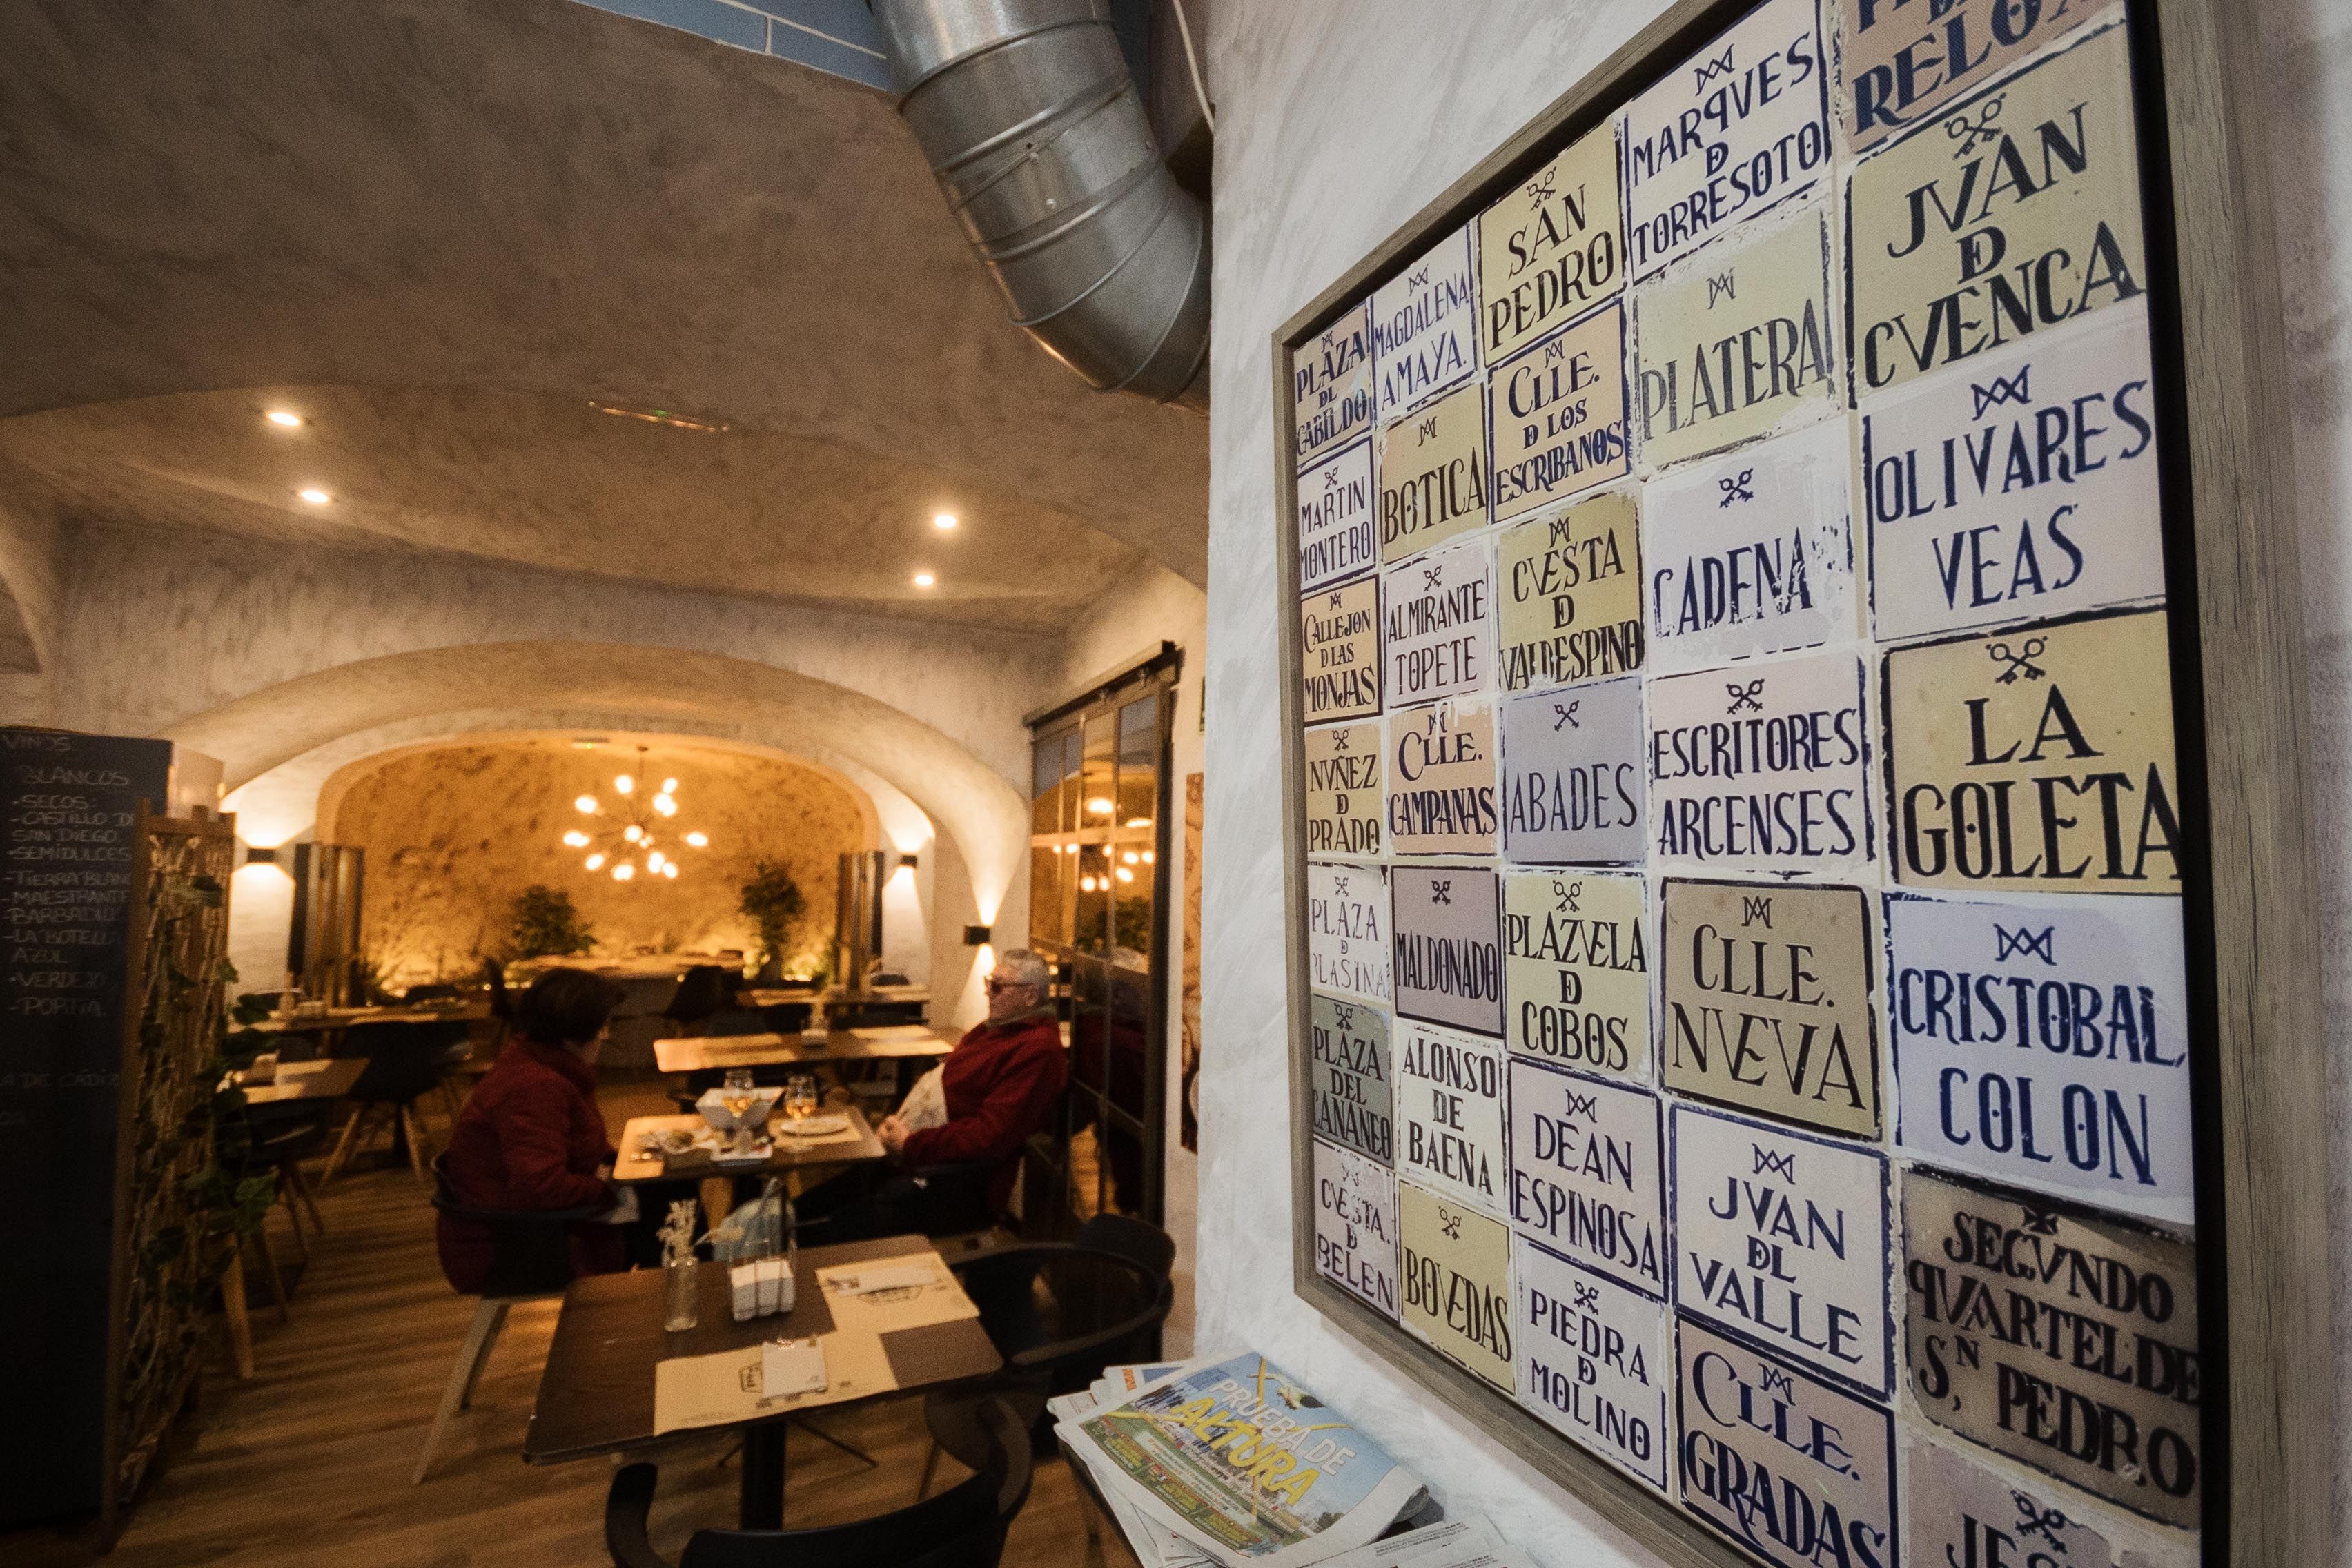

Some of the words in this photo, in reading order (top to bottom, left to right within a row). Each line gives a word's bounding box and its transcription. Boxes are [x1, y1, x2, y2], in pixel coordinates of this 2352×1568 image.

[1852, 0, 2086, 136] RELO
[1633, 121, 1821, 266] TORRESOTO
[1887, 101, 2089, 258] JVAN
[1508, 184, 1585, 280] SAN
[1375, 270, 1469, 361] MAGDALENA
[1489, 231, 1614, 351] PEDRO
[1863, 220, 2146, 387] CVENCA
[1297, 330, 1366, 403] PLAZA
[1640, 297, 1827, 442] PLATERA
[1297, 389, 1366, 456] CABILDO
[1547, 398, 1588, 439] LOS
[1874, 379, 2152, 524] OLIVARES
[1383, 447, 1487, 545] BOTICA
[1496, 420, 1625, 507] ESCRIBANOS
[1301, 475, 1366, 537] MARTIN
[1513, 527, 1625, 602] CVESTA
[1653, 526, 1813, 638] CADENA
[1932, 503, 2083, 610] VEAS
[1304, 609, 1371, 654] CALLEJON
[1389, 580, 1485, 643] ALMIRANTE
[1304, 663, 1375, 714] MONJAS
[1331, 642, 1355, 666] LAS
[1396, 636, 1477, 695] TOPETE
[1499, 619, 1640, 692] VALDESPINO
[3, 734, 72, 752] VINOS
[1654, 708, 1859, 781] ESCRITORES
[1964, 683, 2104, 766] LA
[17, 765, 130, 786] BLANCOS
[1390, 786, 1498, 836] CAMPANAS
[1511, 763, 1638, 833] ABADES
[1309, 818, 1380, 854] PRADO
[1659, 790, 1856, 860] ARCENSES
[1903, 761, 2183, 879] GOLETA
[1311, 899, 1379, 941] PLAZA
[1507, 911, 1647, 972] PLAZVELA
[1396, 930, 1498, 1003] MALDONADO
[1313, 1026, 1384, 1081] PLAZA
[1522, 1001, 1628, 1072] COBOS
[1670, 1000, 1867, 1110] NVEVA
[1899, 968, 2186, 1068] CRISTOBAL
[1330, 1068, 1367, 1104] DEL
[1403, 1037, 1496, 1098] ALONSO
[1433, 1088, 1464, 1132] DE
[1939, 1067, 2157, 1186] COLON
[1409, 1119, 1493, 1197] BAENA
[1534, 1113, 1634, 1193] DEAN
[1514, 1168, 1661, 1284] ESPINOSA
[1709, 1176, 1845, 1260] JVAN
[1318, 1233, 1393, 1311] BELEN
[1404, 1247, 1512, 1364] BOVEDAS
[1689, 1252, 1863, 1364] VALLE
[1531, 1288, 1649, 1386] PIEDRA
[2133, 1333, 2202, 1407] DE
[1208, 1380, 1312, 1452] PRUEBA
[1304, 1438, 1358, 1476] DE
[1531, 1357, 1650, 1462] MOLINO
[1169, 1396, 1320, 1507] ALTURA
[1686, 1429, 1885, 1568] GRADAS
